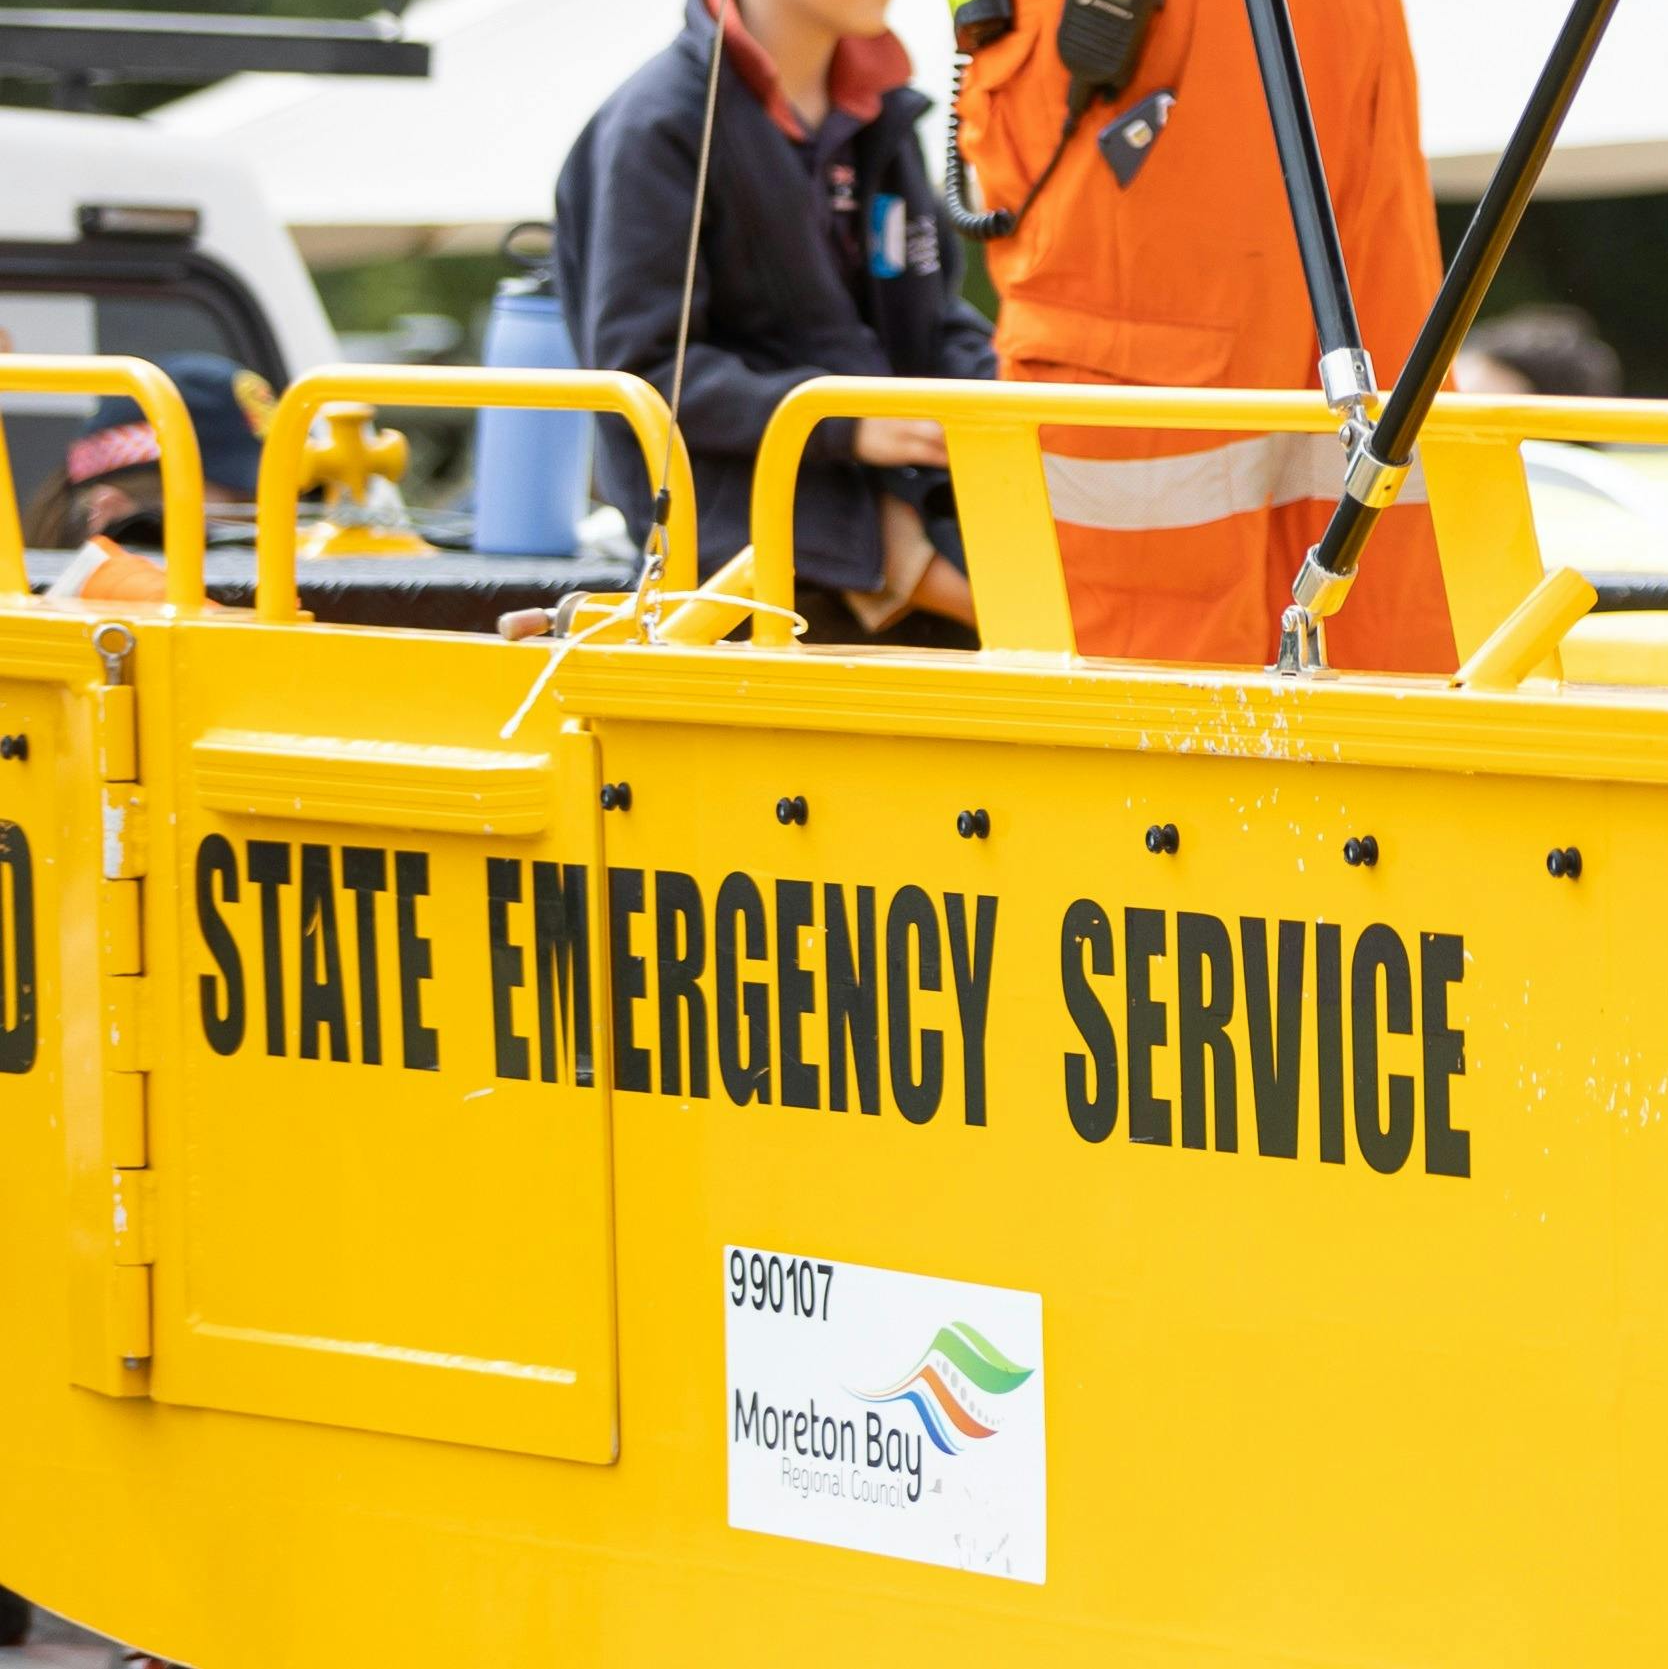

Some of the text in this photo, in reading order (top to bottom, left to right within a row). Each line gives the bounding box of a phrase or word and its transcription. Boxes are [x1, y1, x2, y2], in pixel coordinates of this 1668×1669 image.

[199, 834, 1472, 1179] STATE EMERGENCY SERVICE
[730, 1249, 834, 1322] 990107
[735, 1387, 922, 1503] Moreton Bay
[781, 1456, 907, 1510] Regional Council
